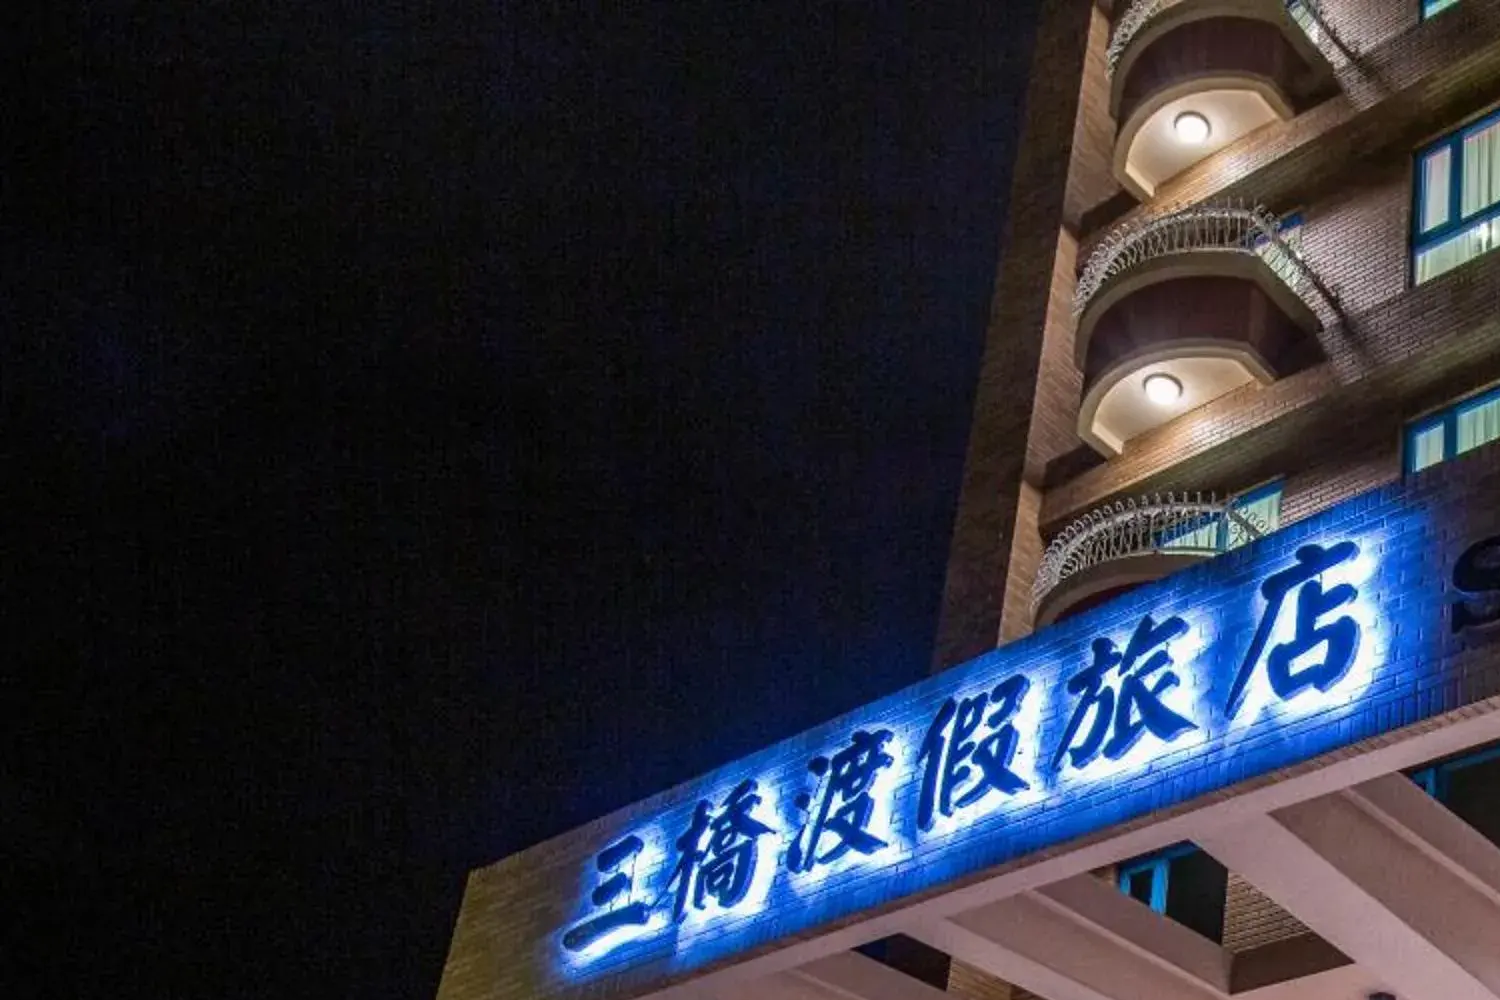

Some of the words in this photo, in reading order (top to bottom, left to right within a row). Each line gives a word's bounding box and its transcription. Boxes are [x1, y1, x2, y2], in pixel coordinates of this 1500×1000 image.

[562, 541, 1362, 953] 三橋渡假旅店
